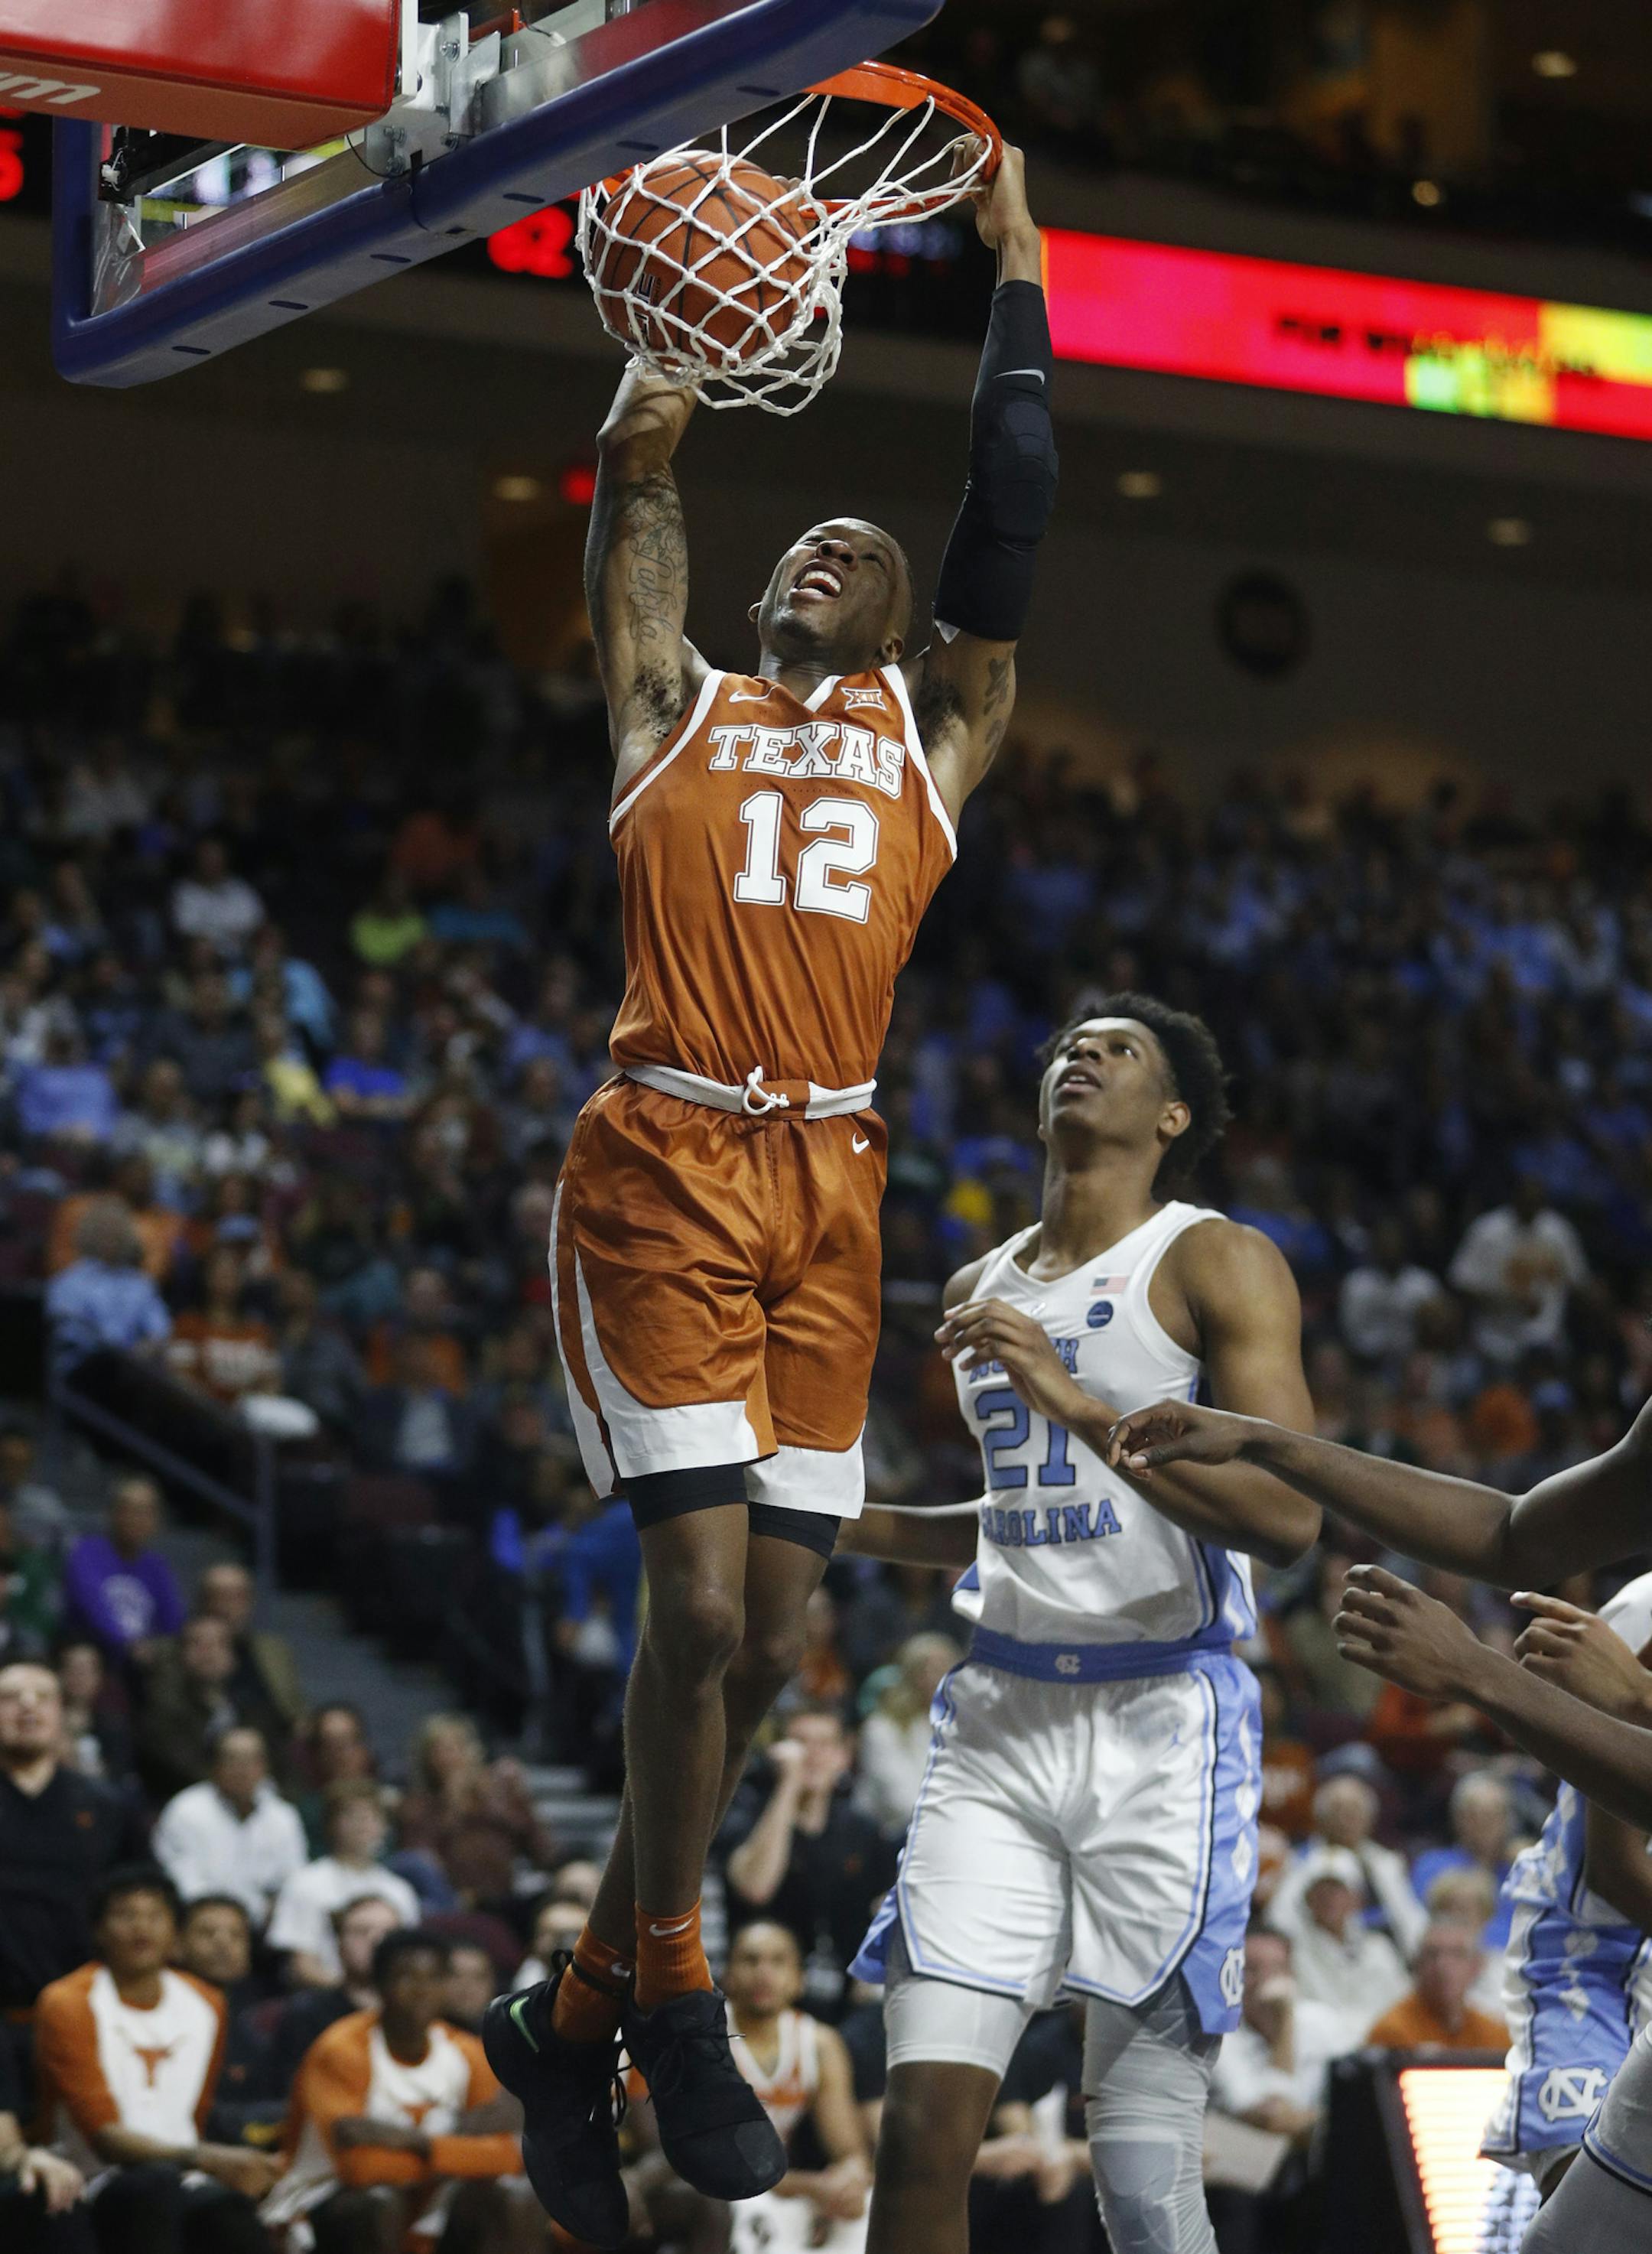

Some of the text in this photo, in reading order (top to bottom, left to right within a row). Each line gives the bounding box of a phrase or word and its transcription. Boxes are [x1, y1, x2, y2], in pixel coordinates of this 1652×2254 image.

[707, 720, 906, 799] TEXAS
[733, 790, 880, 925] 12
[974, 1387, 1075, 1491] 21
[982, 1498, 1122, 1547] AROLINA
